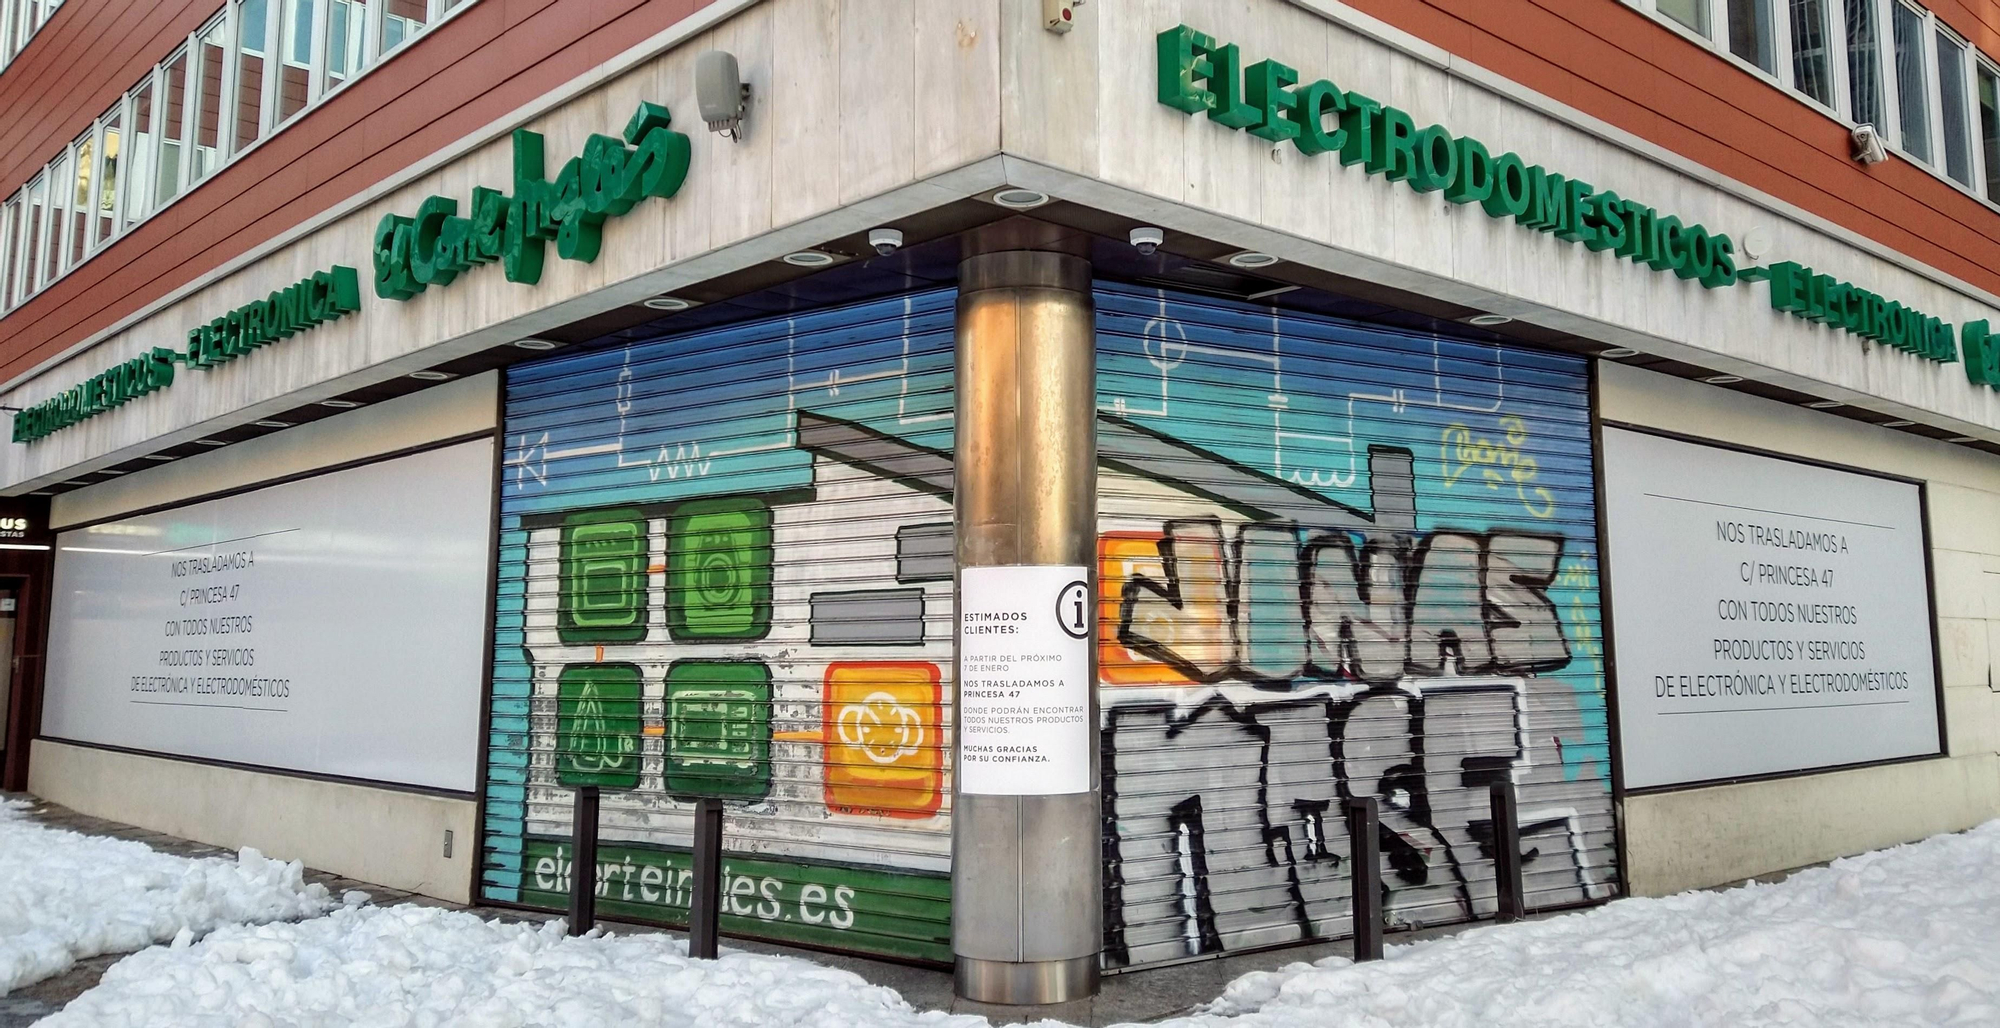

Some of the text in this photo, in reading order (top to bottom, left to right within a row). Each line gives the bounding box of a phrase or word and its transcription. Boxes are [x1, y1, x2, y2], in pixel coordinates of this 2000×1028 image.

[1157, 23, 1738, 289] ELECTRODOMESTICOS
[1769, 260, 1960, 363] ELECTRONICA
[185, 264, 361, 371] ELECTRONICA
[410, 185, 515, 287] Corte
[503, 100, 691, 286] Inglés
[0, 518, 27, 530] US
[1716, 520, 1849, 554] NOS TRASLADAMOS A
[171, 550, 254, 578] NOS TRASLADAMOS A
[1740, 560, 1834, 588] C/ PRINCESA 47
[179, 584, 240, 608] C/ PRINCESA 47
[964, 612, 1028, 622] ESTIMADOS
[1718, 599, 1858, 625] CON TODOS NUESTROS
[165, 615, 253, 637] CON TODOS NUESTROS
[964, 625, 1019, 635] CLIENTES:
[159, 648, 254, 667] PRODUCTOS Y SERVICIOS
[1021, 653, 1062, 662] PRÓXIMO
[1714, 639, 1866, 661] PRODUCTOS Y SERVICIOS
[131, 673, 290, 698] DE ELECTRÓNICA Y ELECTRODOMÉSTICOS
[963, 680, 979, 688] NOS
[981, 680, 1055, 688] TRASLADAMOS
[1655, 668, 1909, 698] DE ELECTRÓNICA Y ELECTRODOMÉSTICOS
[963, 716, 986, 724] TODOS
[991, 706, 1030, 714] PODRÁN
[1033, 706, 1084, 714] ENCONTRAR
[969, 726, 1010, 734] SERVICIOS.
[963, 745, 994, 753] MUCHAS
